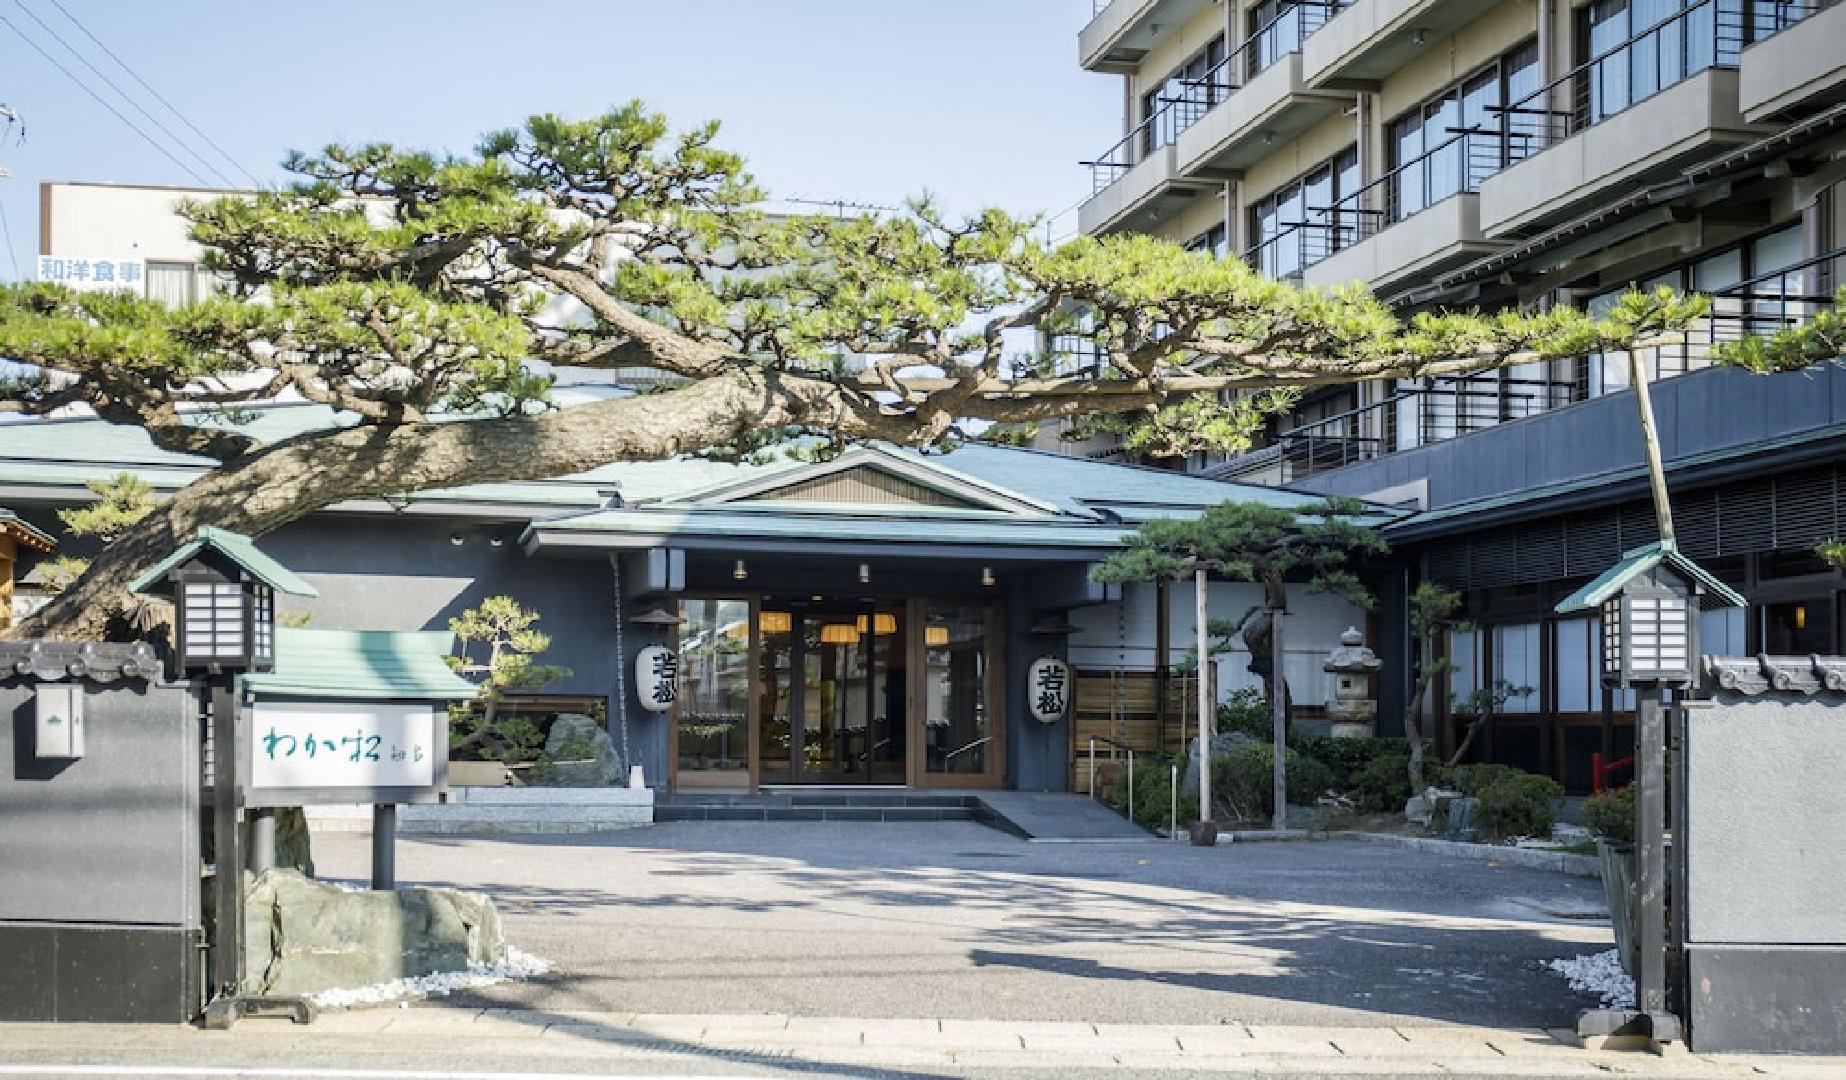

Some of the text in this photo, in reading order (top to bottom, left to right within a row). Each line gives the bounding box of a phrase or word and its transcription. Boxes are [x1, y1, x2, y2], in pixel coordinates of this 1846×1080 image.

[41, 259, 142, 282] 和洋食事
[652, 653, 677, 703] 若松
[1037, 665, 1064, 714] 若松
